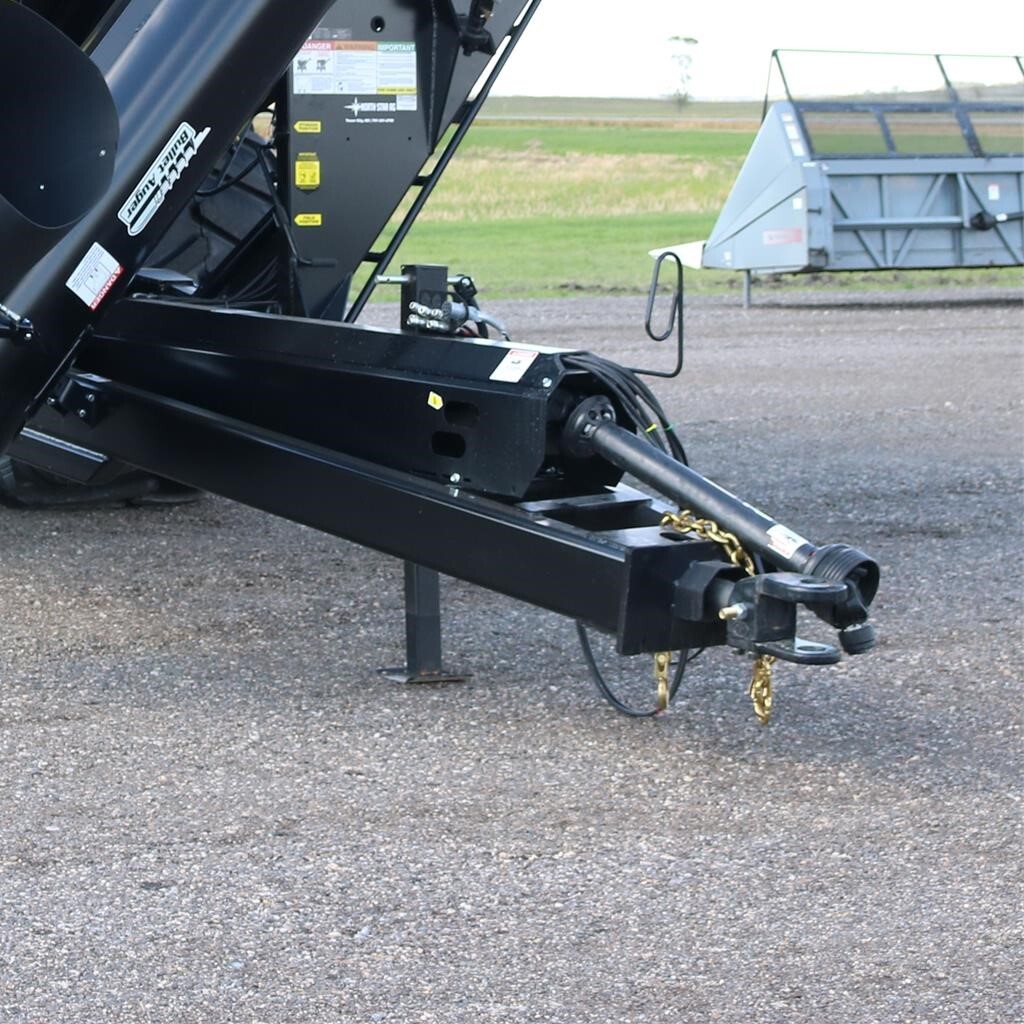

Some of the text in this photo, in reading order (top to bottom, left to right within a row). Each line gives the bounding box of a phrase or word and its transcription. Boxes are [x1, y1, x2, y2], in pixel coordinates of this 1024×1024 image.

[125, 129, 189, 219] Bullet Auger
[90, 272, 118, 310] DANGER
